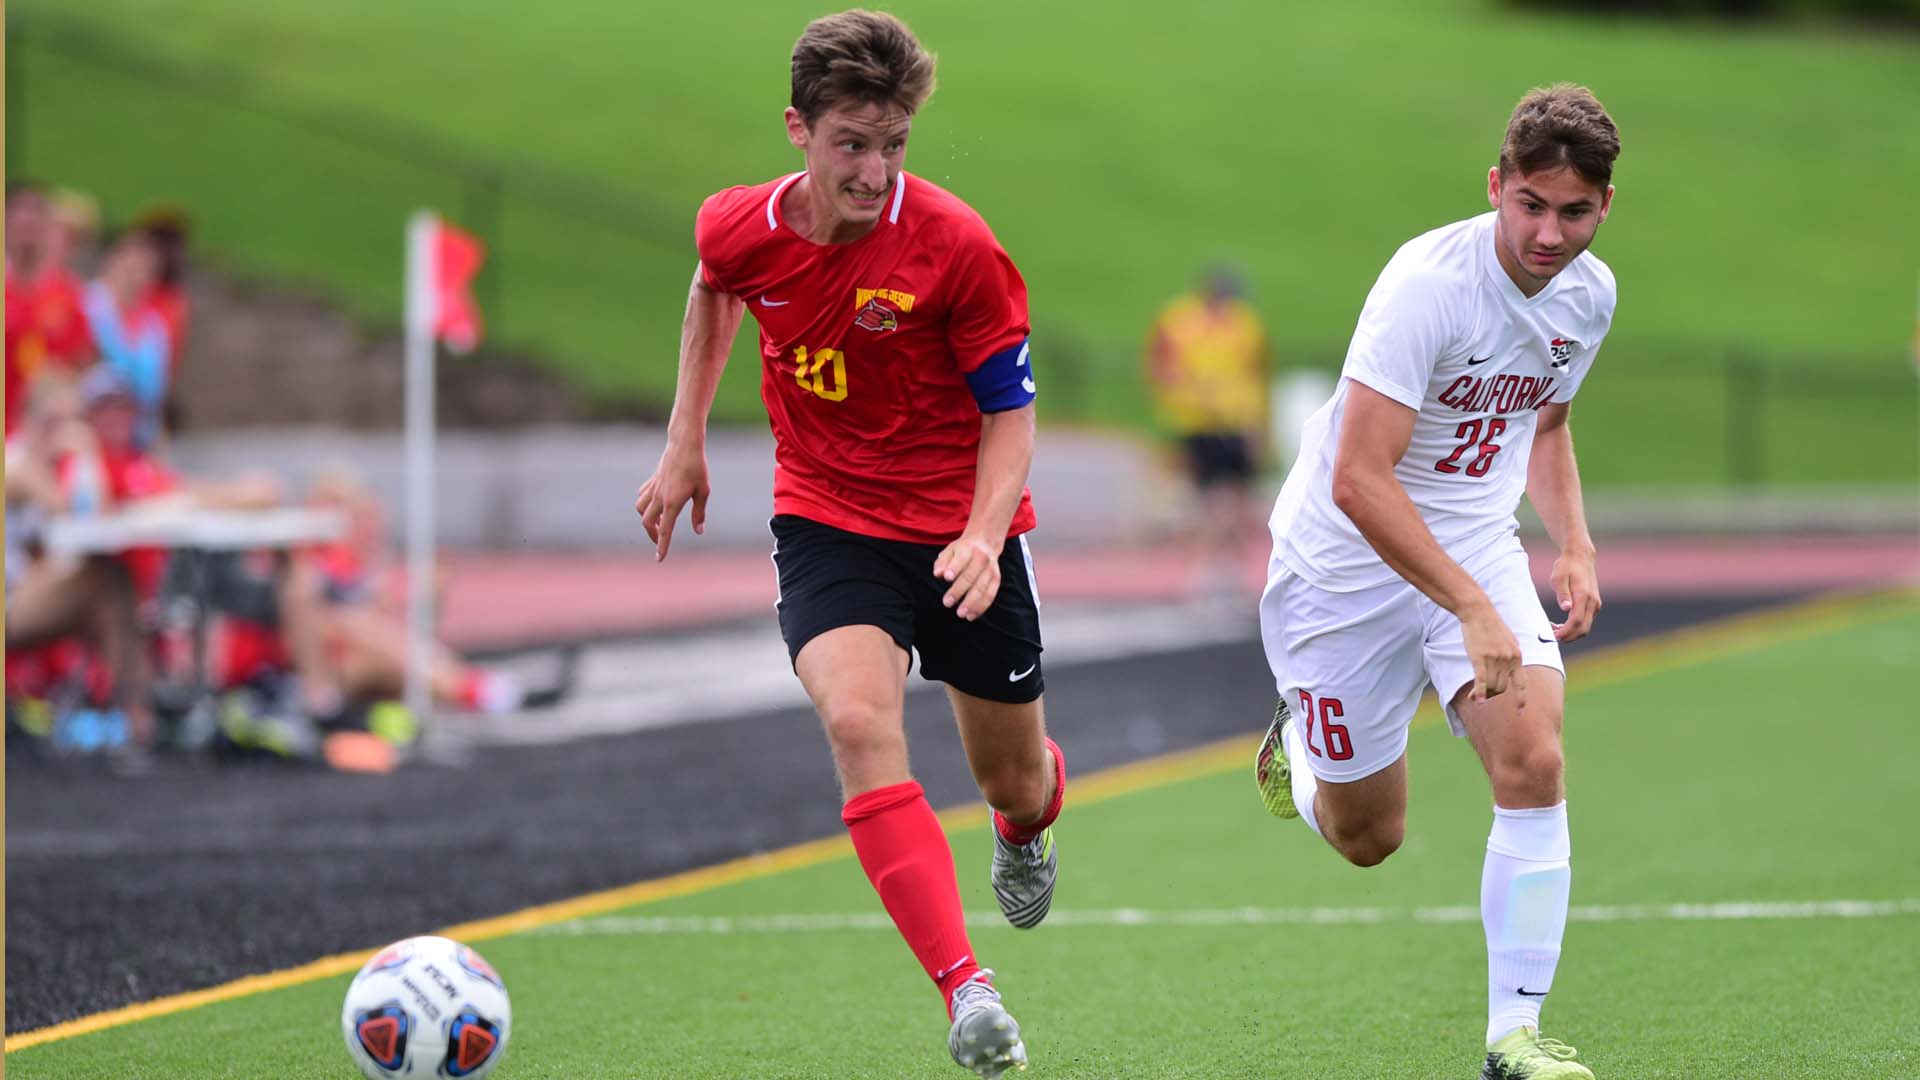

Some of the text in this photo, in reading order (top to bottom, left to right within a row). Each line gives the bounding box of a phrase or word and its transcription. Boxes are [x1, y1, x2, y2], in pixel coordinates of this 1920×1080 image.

[793, 344, 848, 402] 10
[1435, 418, 1506, 478] 26
[1299, 689, 1354, 761] 26
